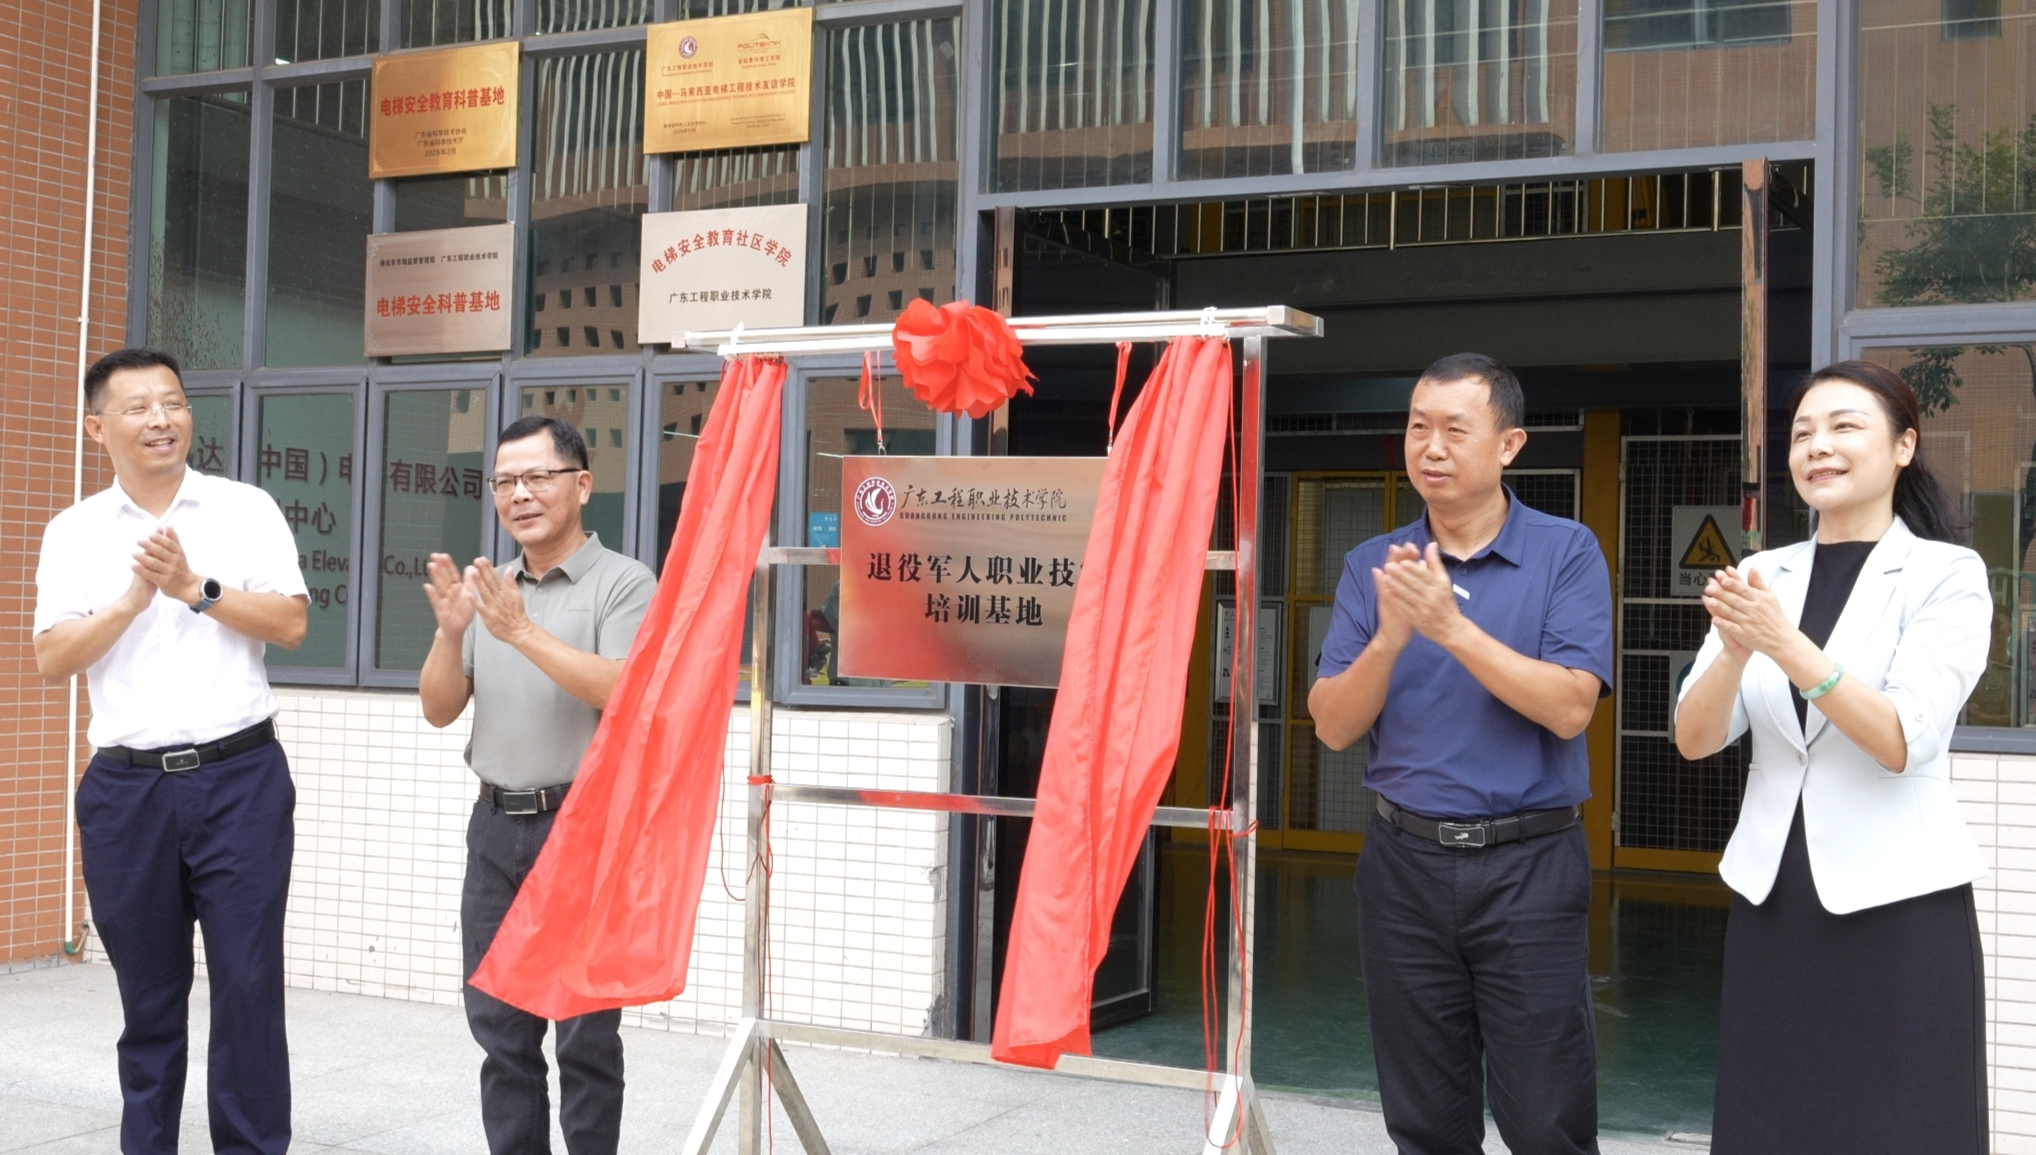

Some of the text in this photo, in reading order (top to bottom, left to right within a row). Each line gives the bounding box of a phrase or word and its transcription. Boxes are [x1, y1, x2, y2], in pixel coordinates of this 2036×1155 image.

[380, 85, 505, 117] 电梯安全教育科普基地
[415, 127, 467, 139] 广东省科学技术协会
[417, 137, 464, 147] 广东省科学技术厅
[425, 148, 457, 157] 2025年2月
[440, 251, 499, 264] 广东工程职业技术学院
[651, 228, 793, 274] 电梯安全教育社区学院
[377, 290, 501, 318] 电梯安全科普基地
[669, 288, 773, 304] 广东工程职业技术学院
[901, 484, 1067, 511] 广东工程职业技术学院
[277, 499, 337, 535] 中心
[900, 512, 1067, 522] GUANGDONG ENGINEERING POLYTECHNIC
[867, 552, 1085, 588] 退役军人职业技
[1679, 571, 1714, 586] 当心
[924, 593, 1043, 627] 培训基地
